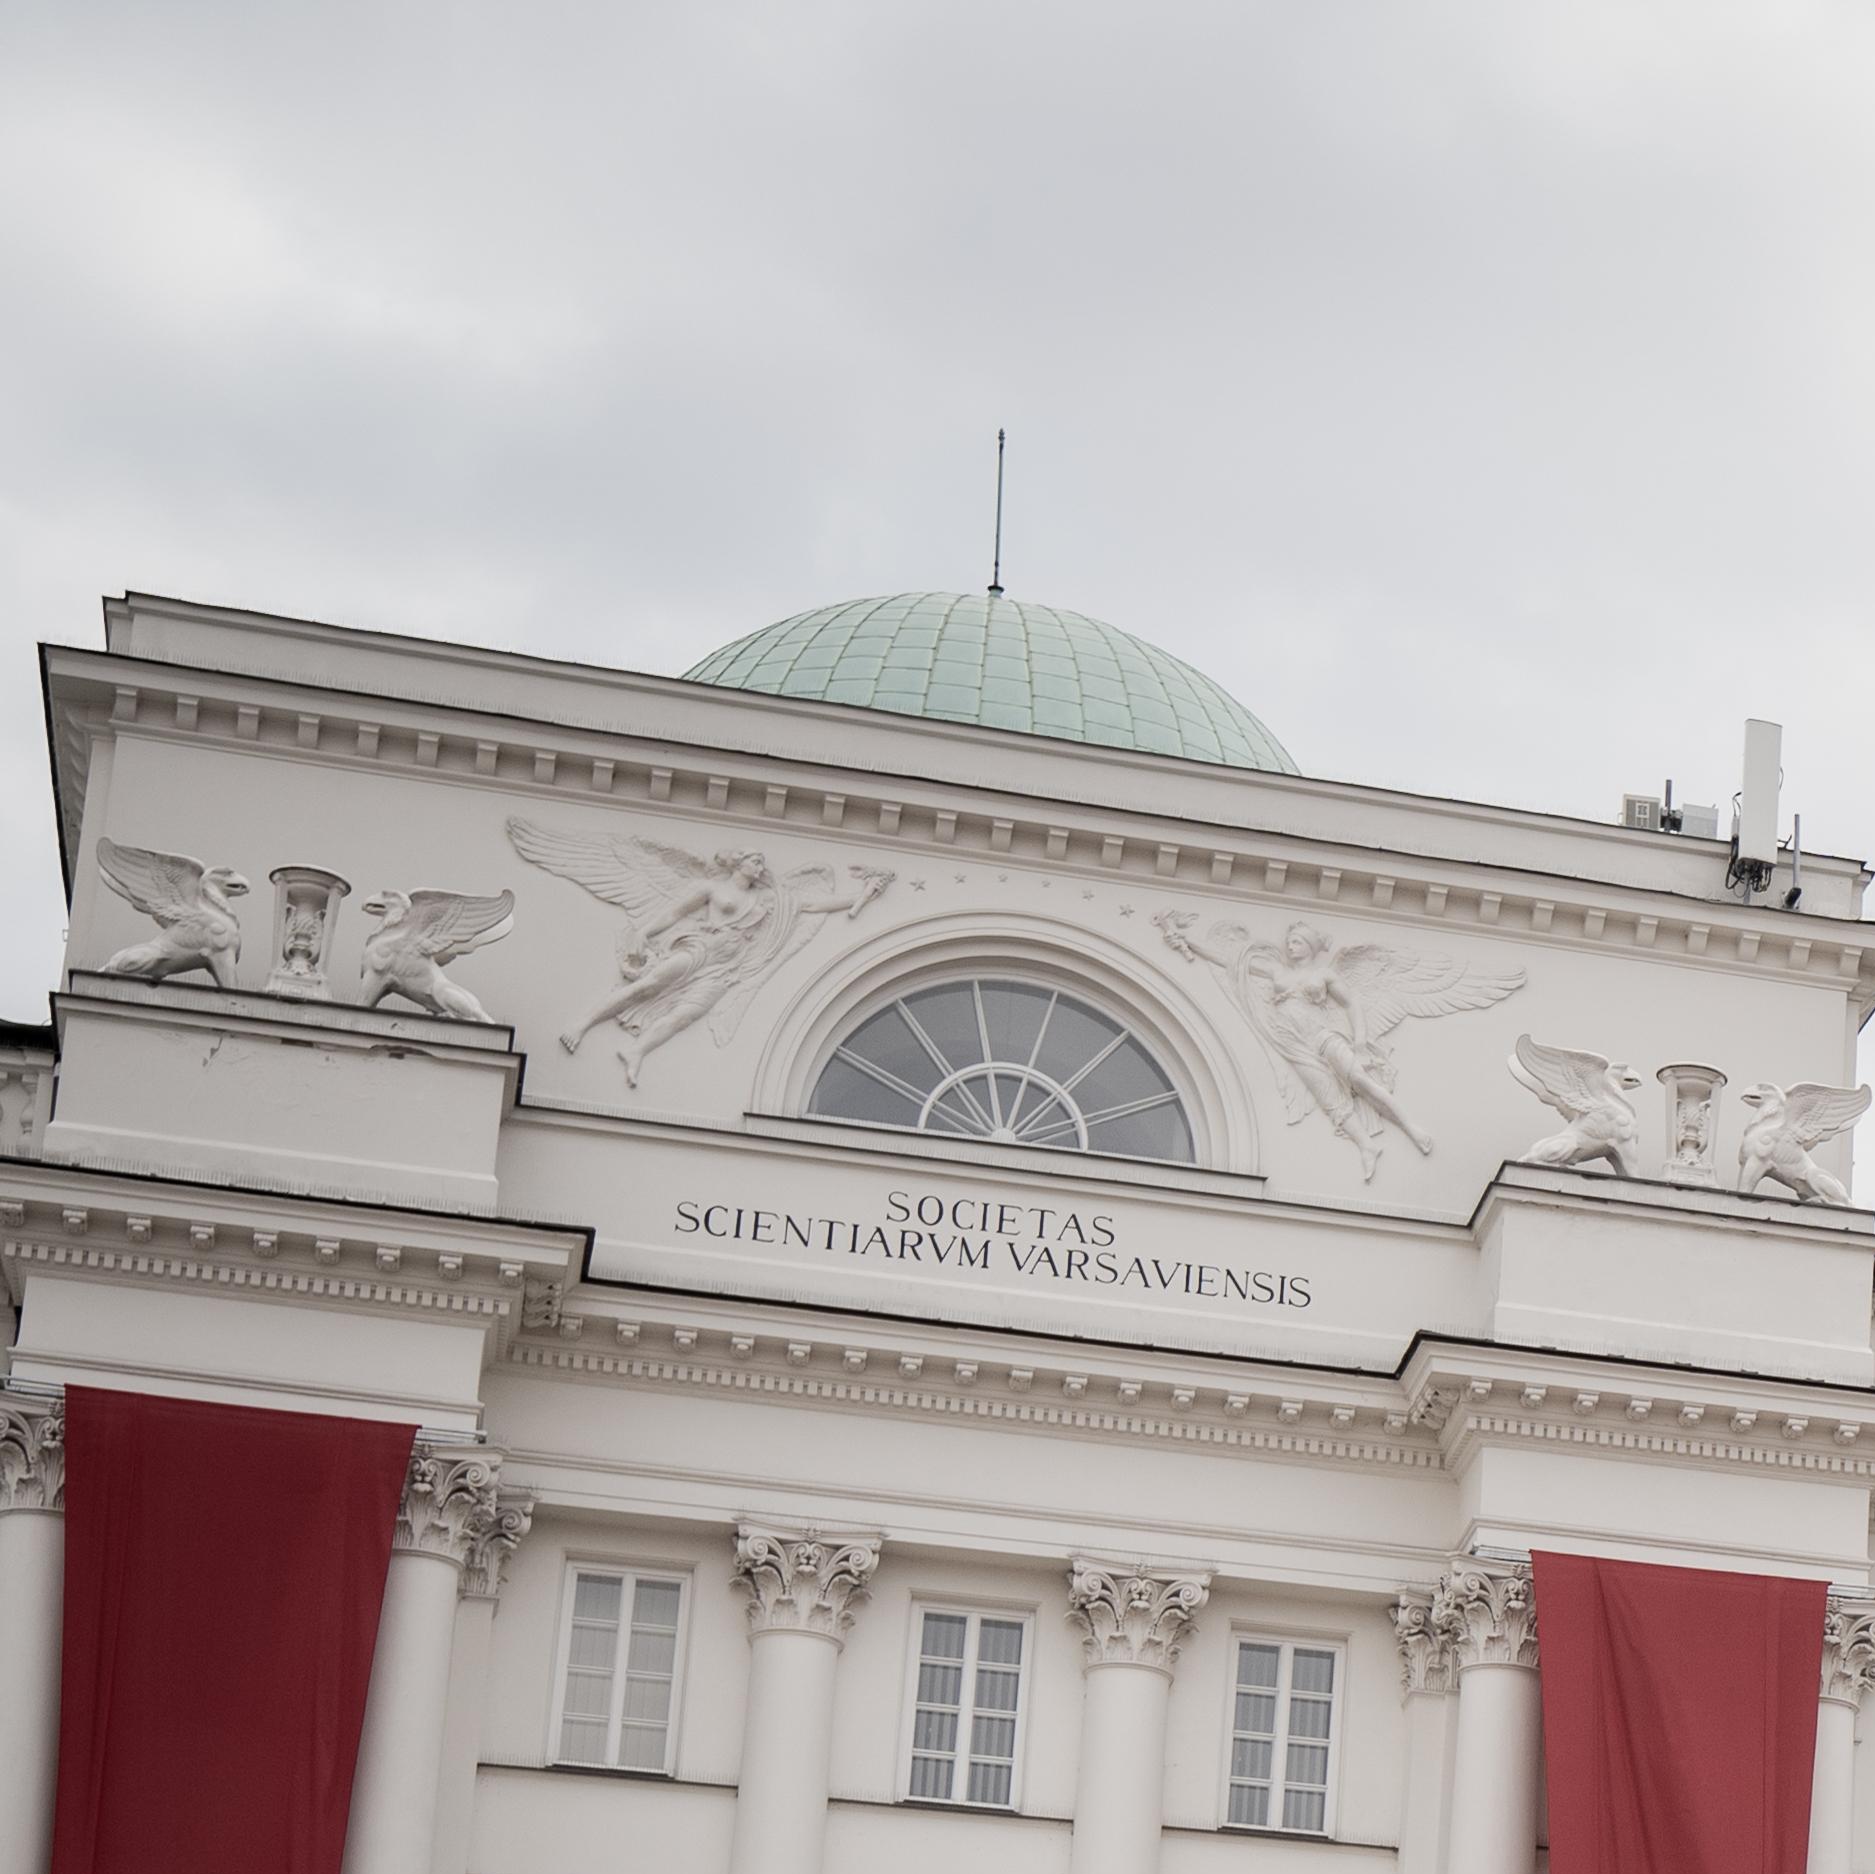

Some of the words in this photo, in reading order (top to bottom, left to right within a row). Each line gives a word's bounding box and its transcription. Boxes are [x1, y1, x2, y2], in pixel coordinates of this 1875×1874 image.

[674, 1201, 992, 1269] SCIENTIARVM
[1007, 1242, 1312, 1308] VARSAVIENSIS
[886, 1190, 1116, 1247] SOCIETAS
